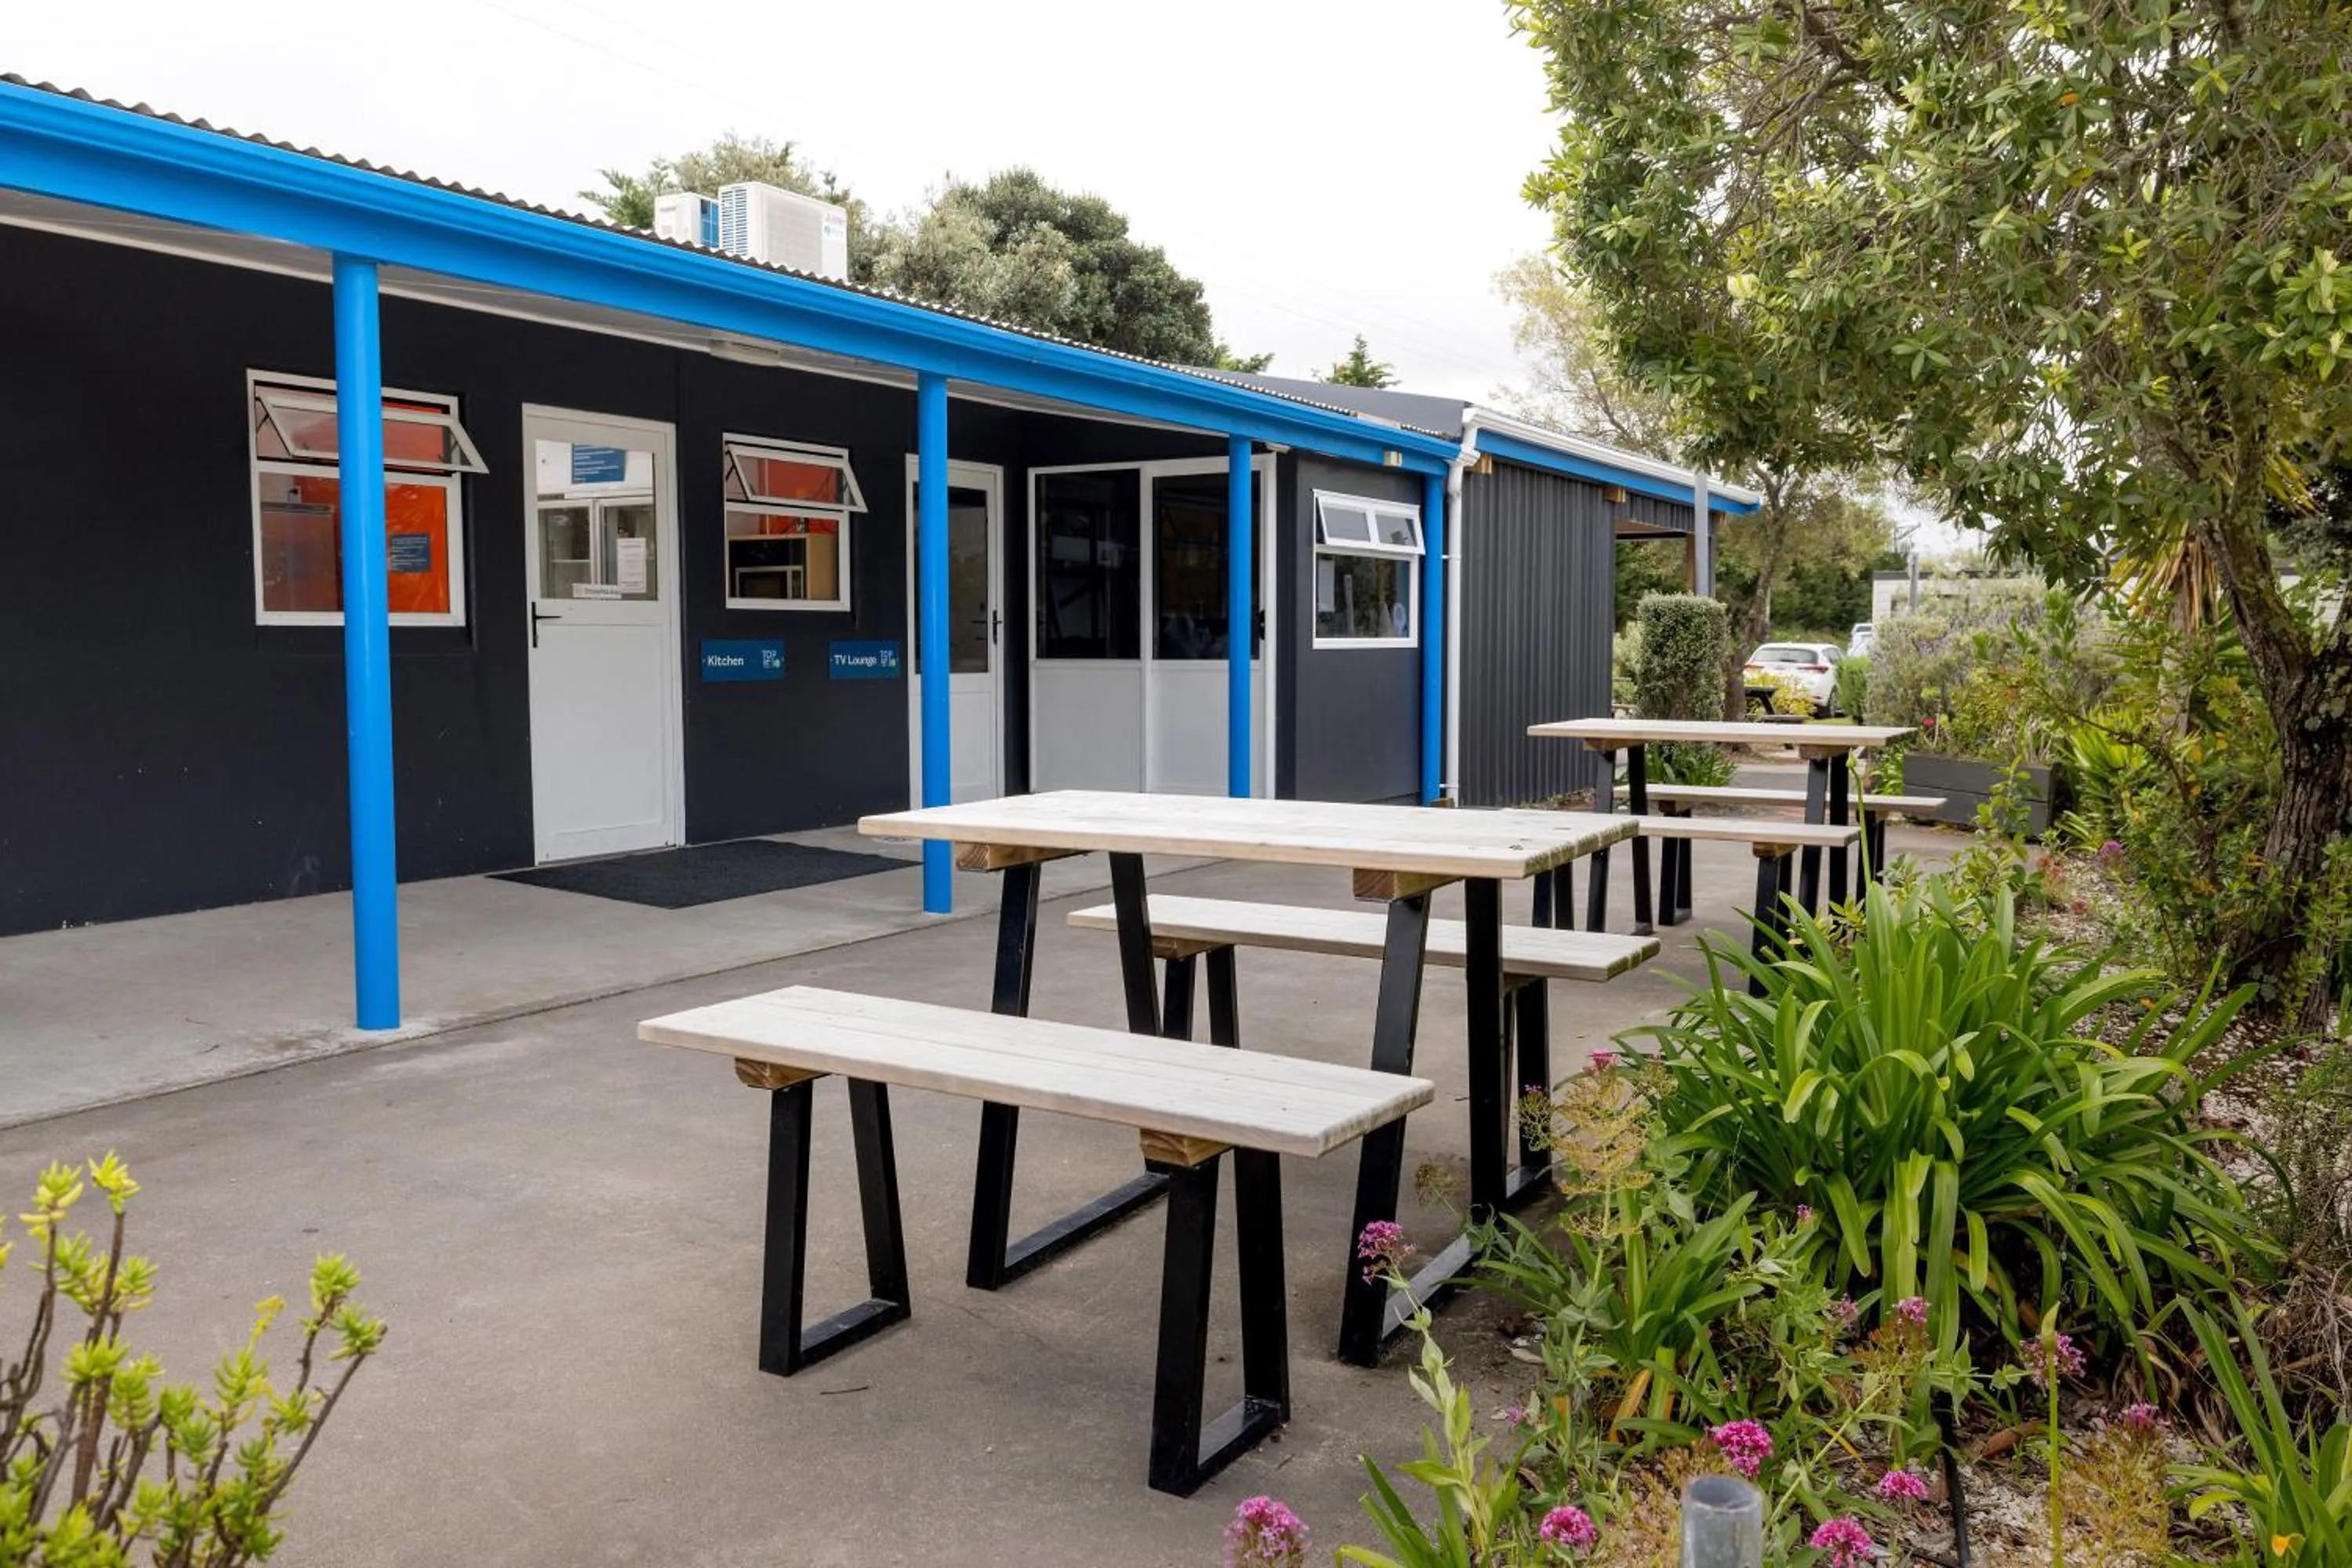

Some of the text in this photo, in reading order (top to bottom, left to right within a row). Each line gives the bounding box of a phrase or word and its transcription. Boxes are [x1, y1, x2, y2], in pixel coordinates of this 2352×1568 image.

[707, 655, 744, 666] Kitchen
[833, 655, 847, 666] TV
[848, 655, 878, 668] Lounge
